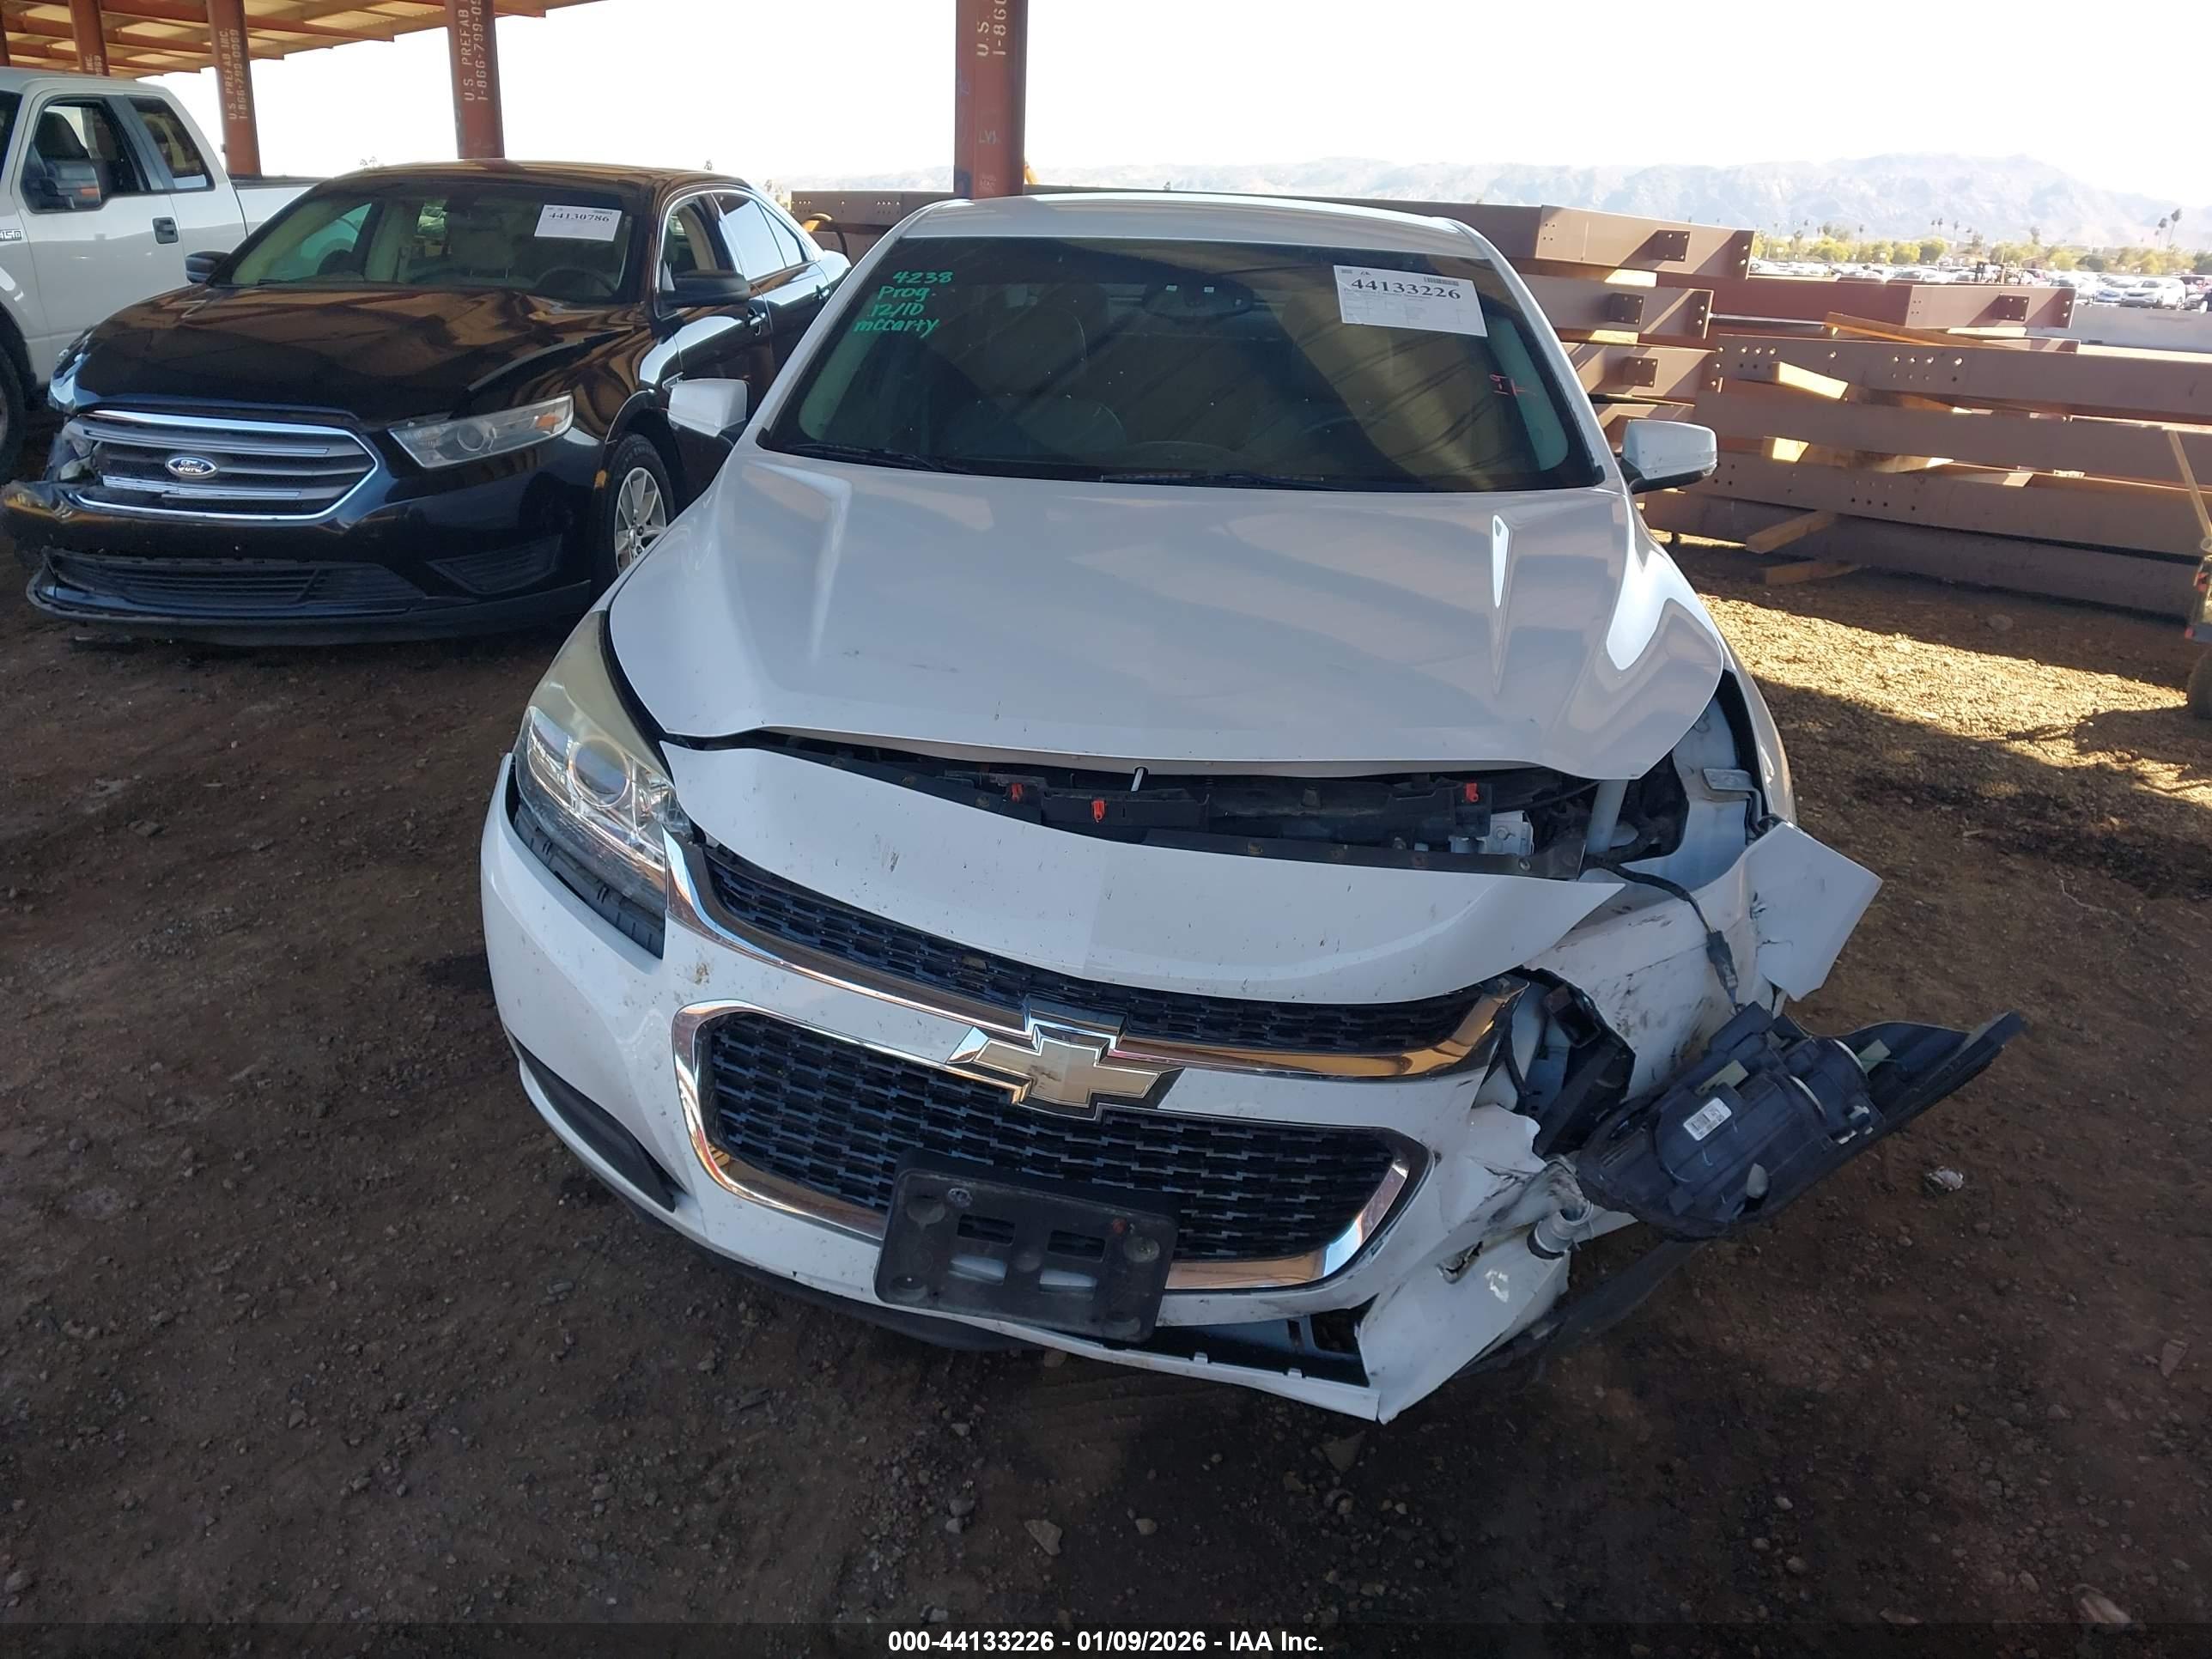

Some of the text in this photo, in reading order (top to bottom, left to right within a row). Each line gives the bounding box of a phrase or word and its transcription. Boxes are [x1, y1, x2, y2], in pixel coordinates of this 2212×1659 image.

[220, 27, 230, 48] INC.
[458, 9, 472, 65] PREFAB
[976, 15, 989, 57] U.S.
[222, 52, 234, 94] PREFAB
[549, 212, 611, 222] 44130786
[893, 270, 954, 283] 4238
[1352, 278, 1462, 300] 44133226
[870, 302, 925, 318] 12/10
[178, 459, 204, 473] Ford
